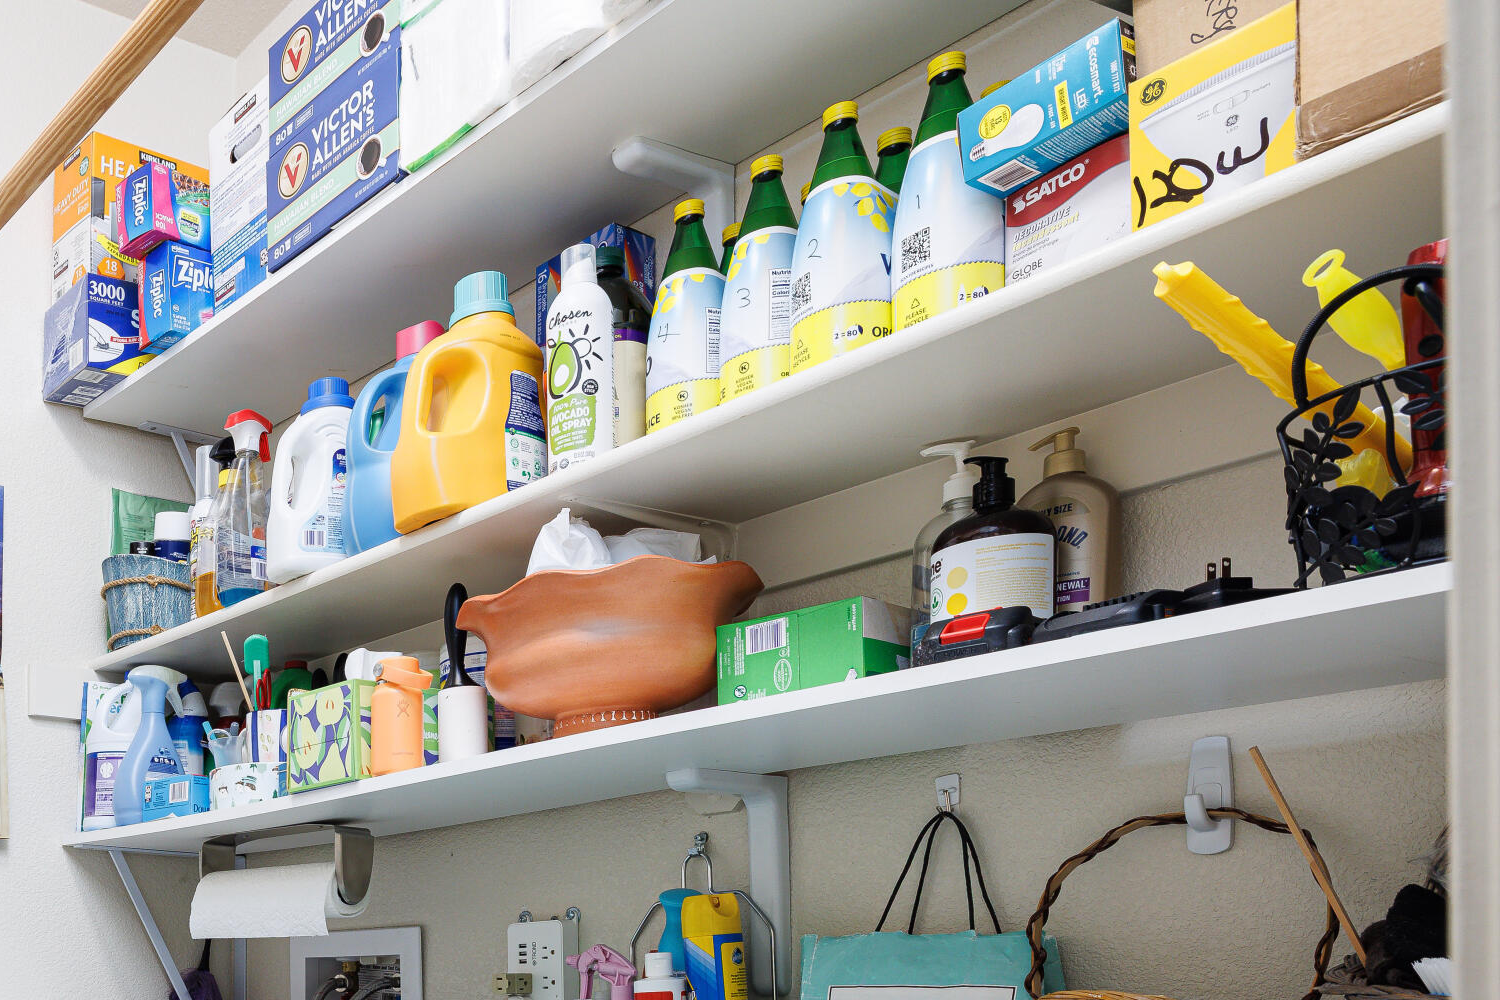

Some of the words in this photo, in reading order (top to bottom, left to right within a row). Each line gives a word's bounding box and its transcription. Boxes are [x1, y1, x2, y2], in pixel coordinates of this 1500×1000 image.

[311, 79, 374, 144] VICTOR
[311, 99, 376, 172] ALLEN'S
[1025, 163, 1086, 207] SATCO
[133, 179, 149, 227] Ziploc
[1013, 206, 1071, 244] DECORATIVE
[274, 244, 286, 260] 80
[807, 238, 822, 259] 2
[105, 259, 118, 271] 18
[1012, 258, 1043, 280] GLOBE
[177, 259, 213, 292] Zipl
[537, 268, 548, 284] 16
[88, 280, 126, 302] 3000
[89, 295, 111, 305] SQUARE
[150, 274, 165, 319] Ziploc
[736, 287, 751, 309] 3
[972, 290, 984, 299] 80
[548, 309, 593, 330] Chosen
[905, 306, 927, 321] PLEASE
[657, 323, 681, 343] 4
[847, 329, 858, 337] 80
[735, 374, 754, 384] KOSHER
[736, 380, 753, 389] VEGAN
[551, 406, 590, 427] AVOCADO
[673, 402, 693, 411] KOSHER
[675, 407, 691, 415] VEGAN
[551, 424, 562, 437] OIL
[562, 417, 593, 432] SPRAY
[1053, 502, 1074, 515] SIZE
[1057, 525, 1089, 547] OND
[1056, 579, 1086, 592] NEWAL
